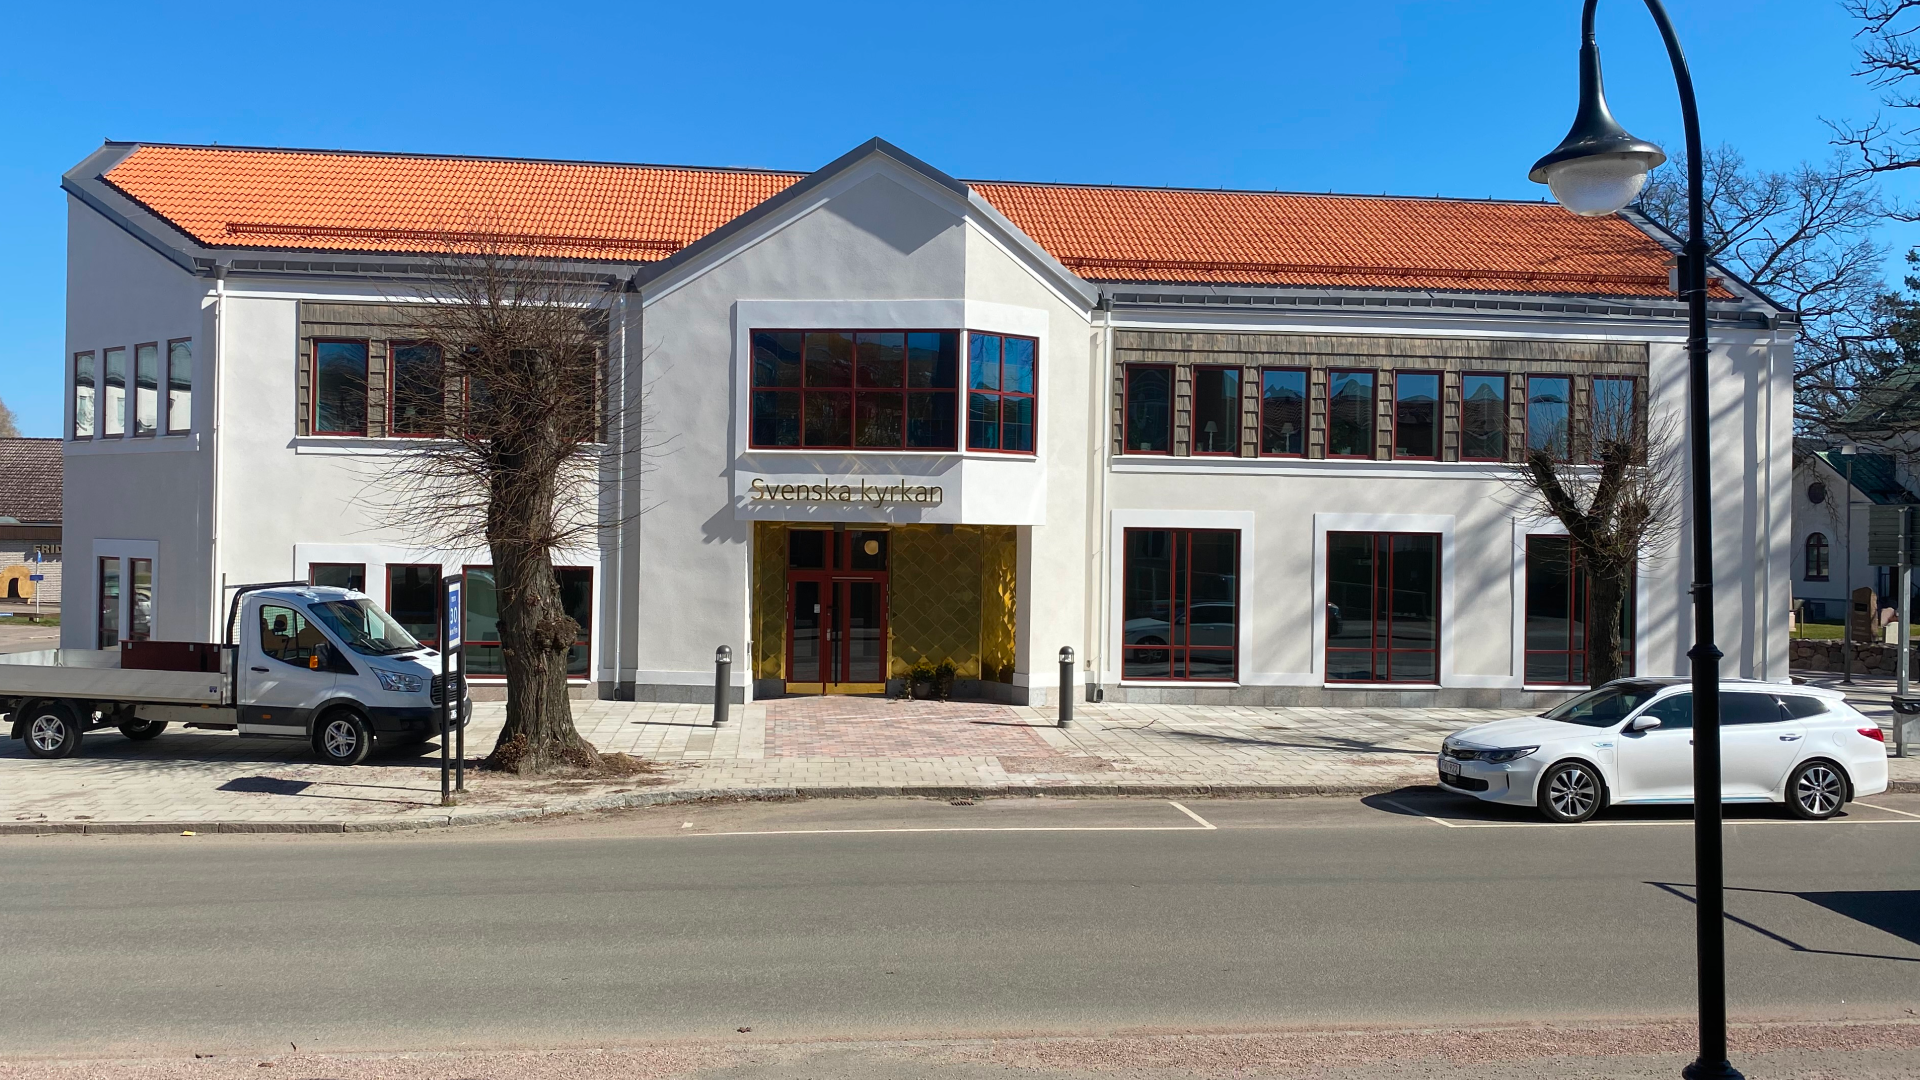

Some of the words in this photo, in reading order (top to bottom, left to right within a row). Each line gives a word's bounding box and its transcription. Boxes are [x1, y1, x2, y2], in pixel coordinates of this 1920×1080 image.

[751, 478, 850, 502] Svenska
[861, 478, 943, 508] kyrkan
[449, 606, 458, 625] 30
